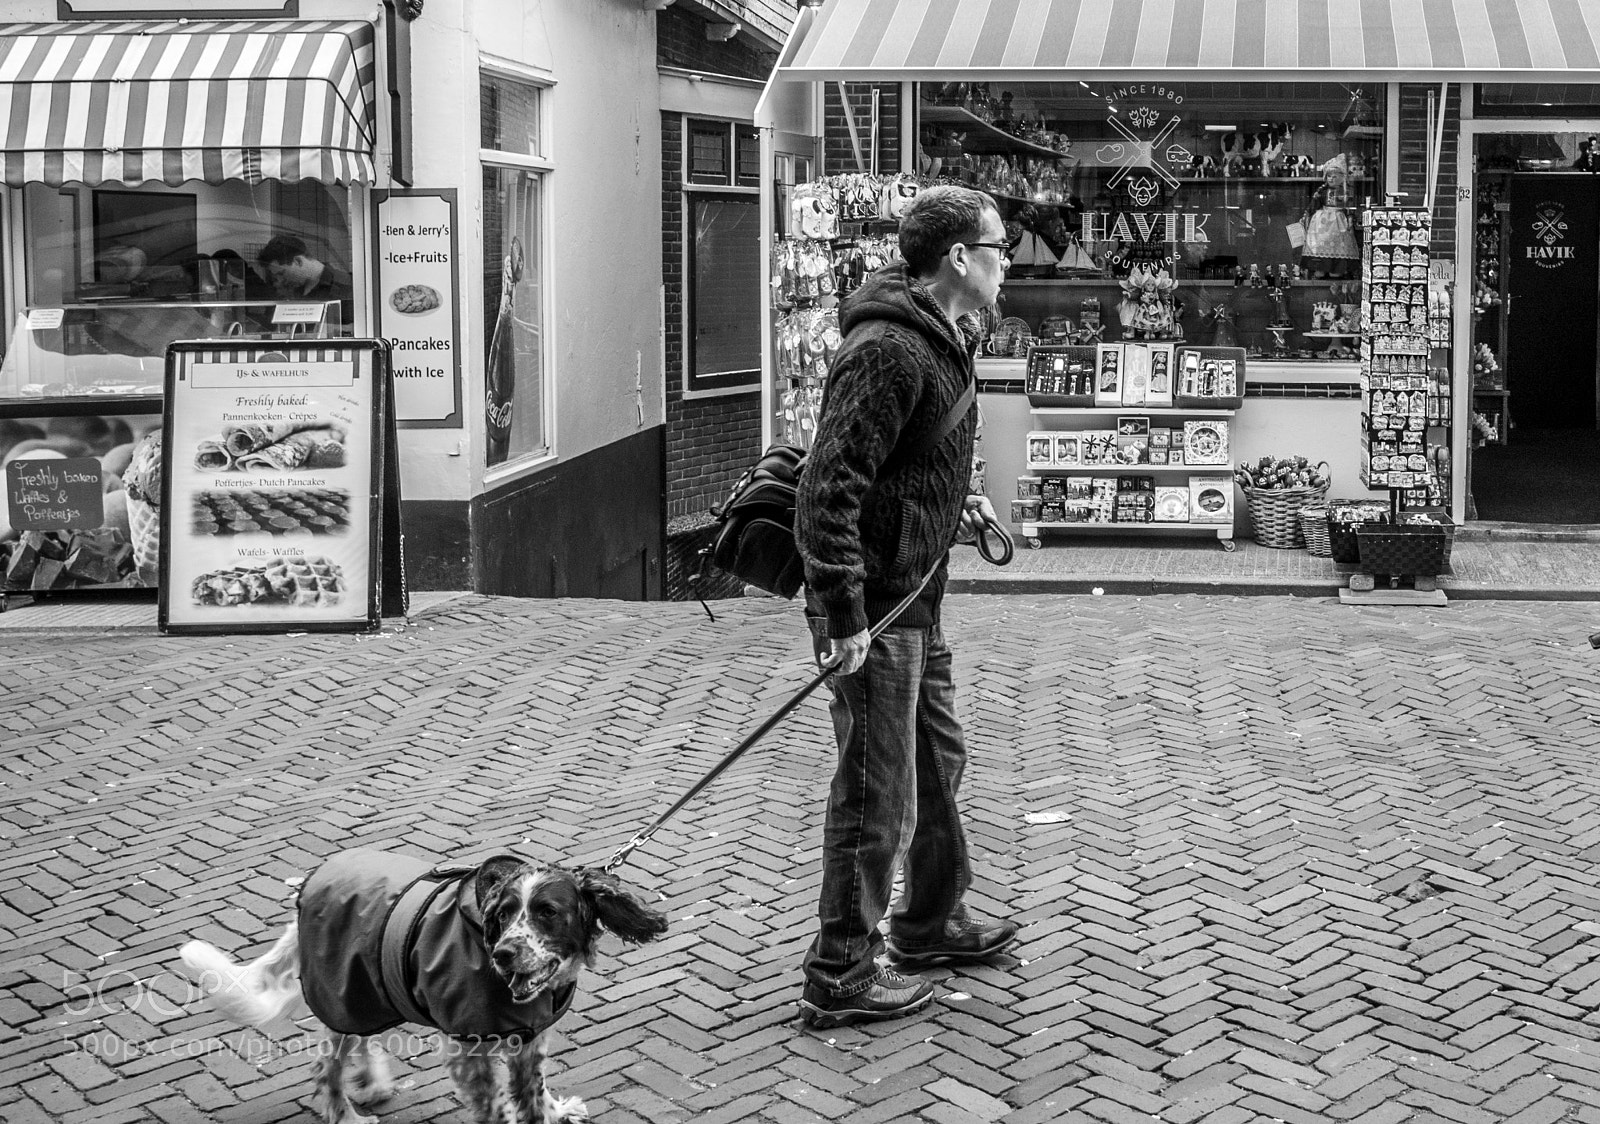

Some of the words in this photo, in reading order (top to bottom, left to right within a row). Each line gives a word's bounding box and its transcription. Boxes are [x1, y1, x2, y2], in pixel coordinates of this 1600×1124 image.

[1105, 84, 1146, 104] SINCE
[1151, 85, 1184, 104] 1880
[1459, 188, 1471, 199] 32
[407, 224, 415, 236] &
[417, 224, 449, 238] Jerry's
[1079, 212, 1211, 242] HAVIK
[1526, 246, 1575, 258] HAVIK
[1104, 250, 1182, 272] SOUVENIRS
[391, 336, 450, 350] Pancakes
[251, 369, 260, 377] &
[393, 366, 422, 378] with
[426, 366, 444, 378] Ice
[235, 394, 275, 411] Freshly
[259, 478, 285, 487] Dutch
[287, 477, 326, 487] Pancakes
[57, 489, 69, 504] &
[272, 547, 305, 556] Waffles
